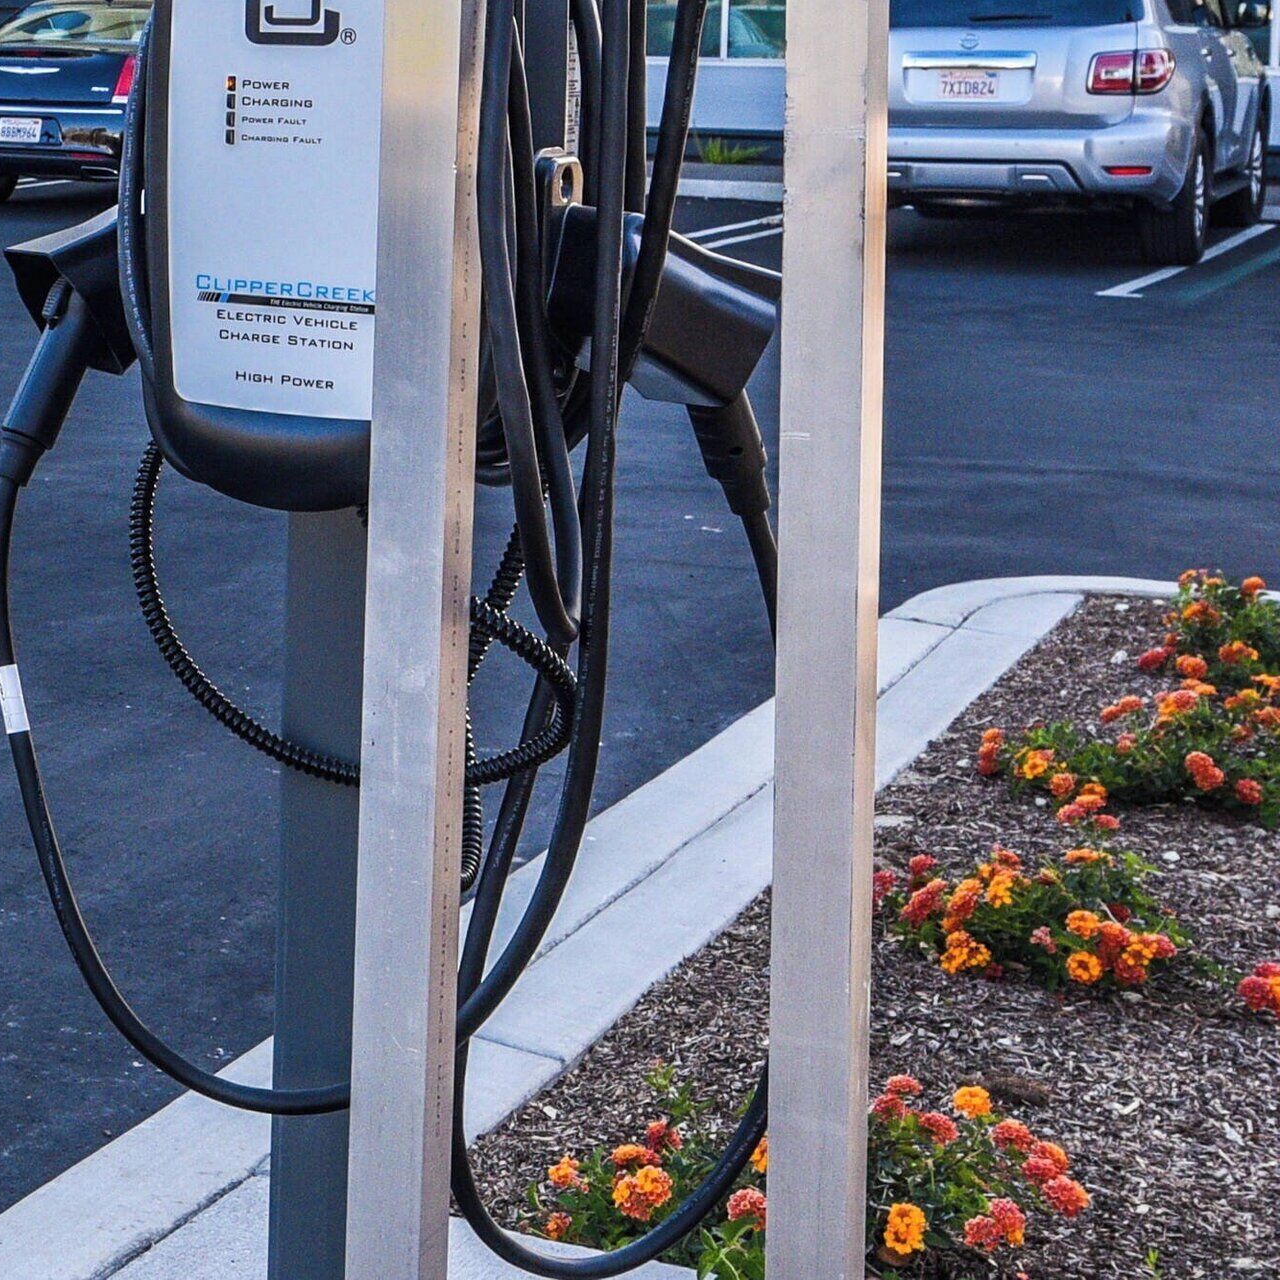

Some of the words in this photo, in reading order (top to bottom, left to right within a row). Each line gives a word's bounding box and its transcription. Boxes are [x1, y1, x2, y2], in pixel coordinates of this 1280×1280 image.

[242, 79, 290, 90] POWER
[941, 80, 995, 95] 7XID824
[241, 96, 313, 108] CHARGING
[216, 309, 287, 325] ELECTRIC
[293, 315, 358, 331] VEHICLE
[219, 329, 280, 344] CHARGE
[287, 335, 354, 351] STATION
[235, 371, 273, 384] HIGH
[281, 375, 335, 390] POWER
